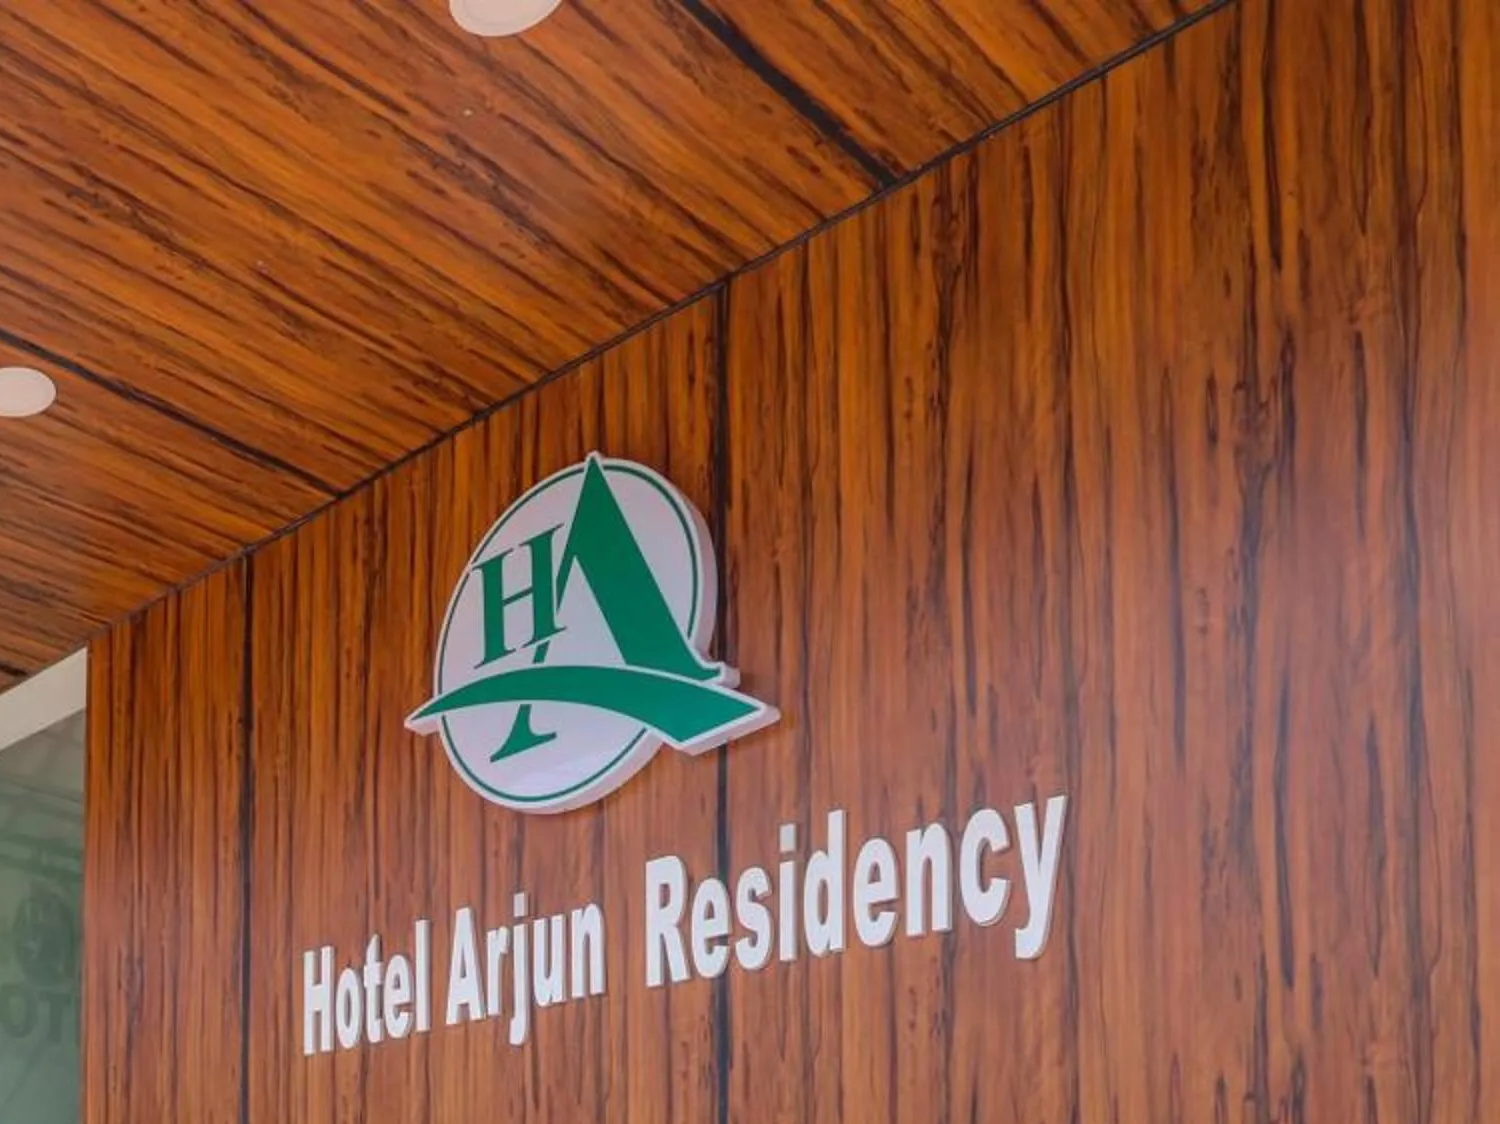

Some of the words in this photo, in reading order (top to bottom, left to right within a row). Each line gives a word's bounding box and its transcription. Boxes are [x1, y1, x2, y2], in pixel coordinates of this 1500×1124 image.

[303, 920, 431, 1056] Hotel
[445, 893, 605, 1047] Arjun
[644, 795, 1067, 988] Residency
